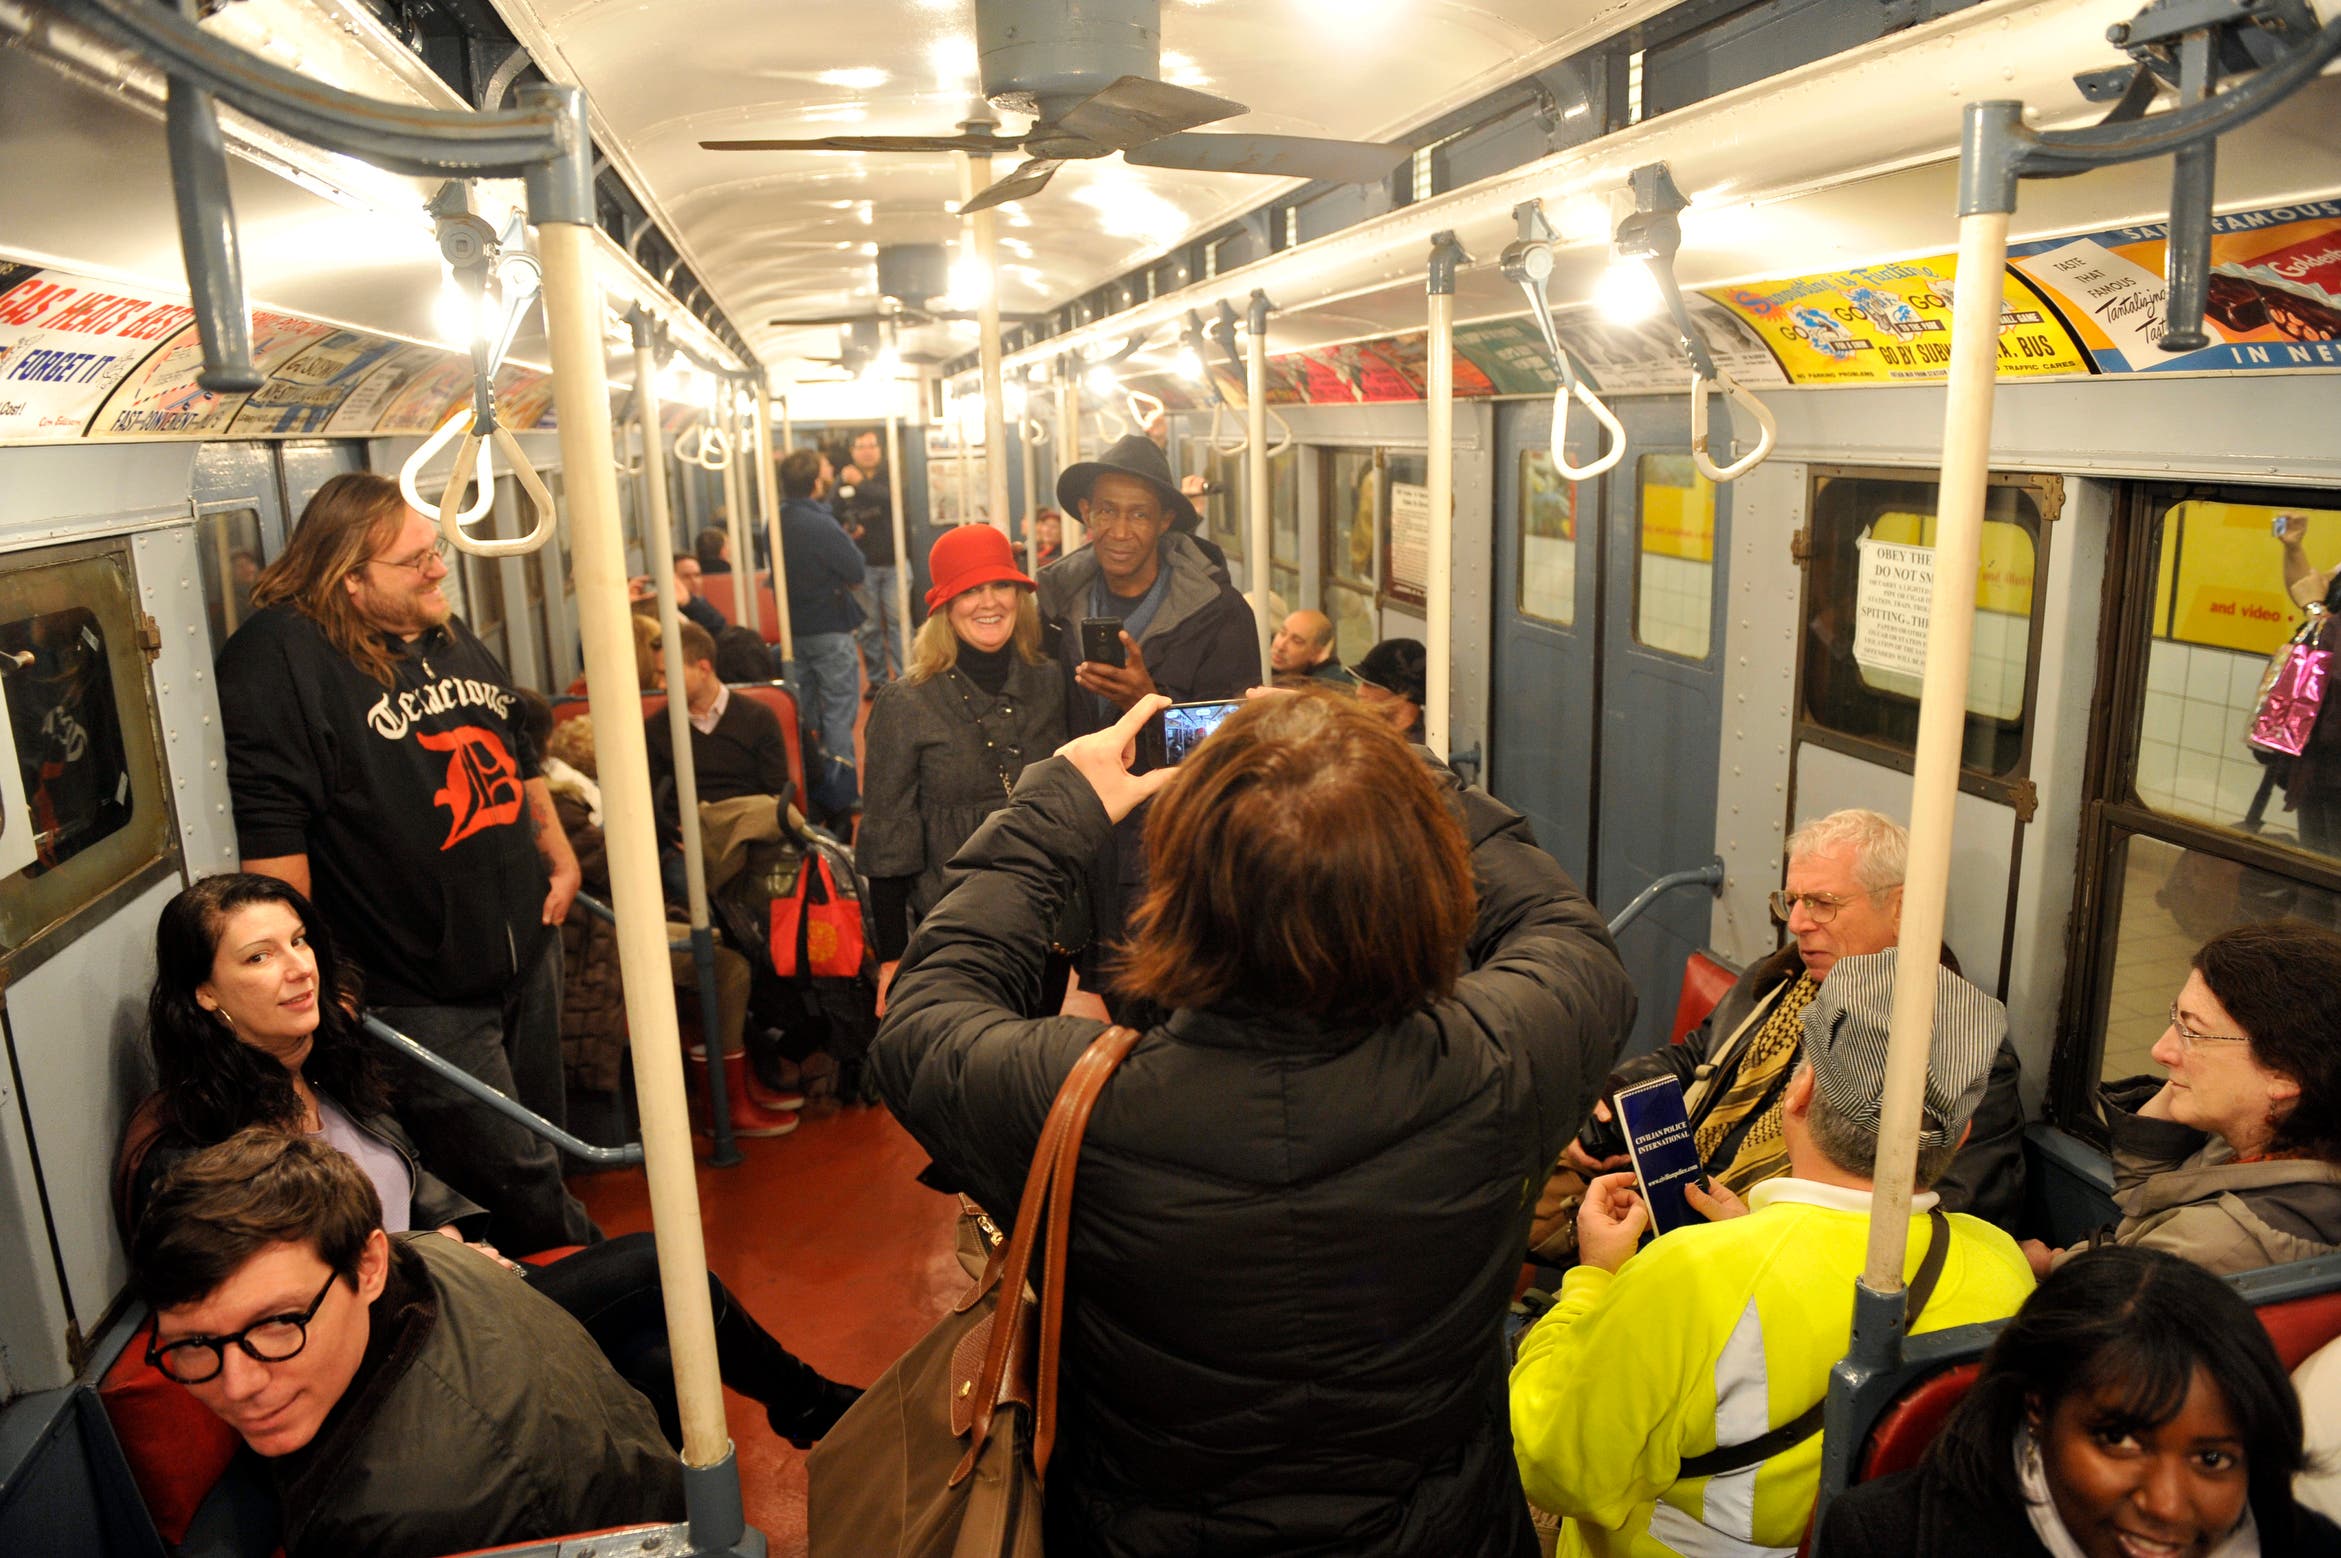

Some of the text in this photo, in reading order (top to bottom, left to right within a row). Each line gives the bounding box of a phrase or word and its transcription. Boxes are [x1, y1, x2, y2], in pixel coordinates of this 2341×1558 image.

[2053, 257, 2087, 272] TASTE
[2267, 248, 2341, 278] Goldenb
[2074, 269, 2107, 284] THAT
[2087, 277, 2137, 298] FAMOUS
[0, 279, 197, 341] GAS HEATS BEST
[1908, 294, 1946, 310] GO
[1834, 306, 1868, 321] GO
[1780, 325, 1809, 341] GO
[2135, 317, 2167, 344] Tast
[1879, 346, 1899, 365] GO
[1897, 345, 1916, 365] BY
[2016, 334, 2056, 358] BUS
[2230, 343, 2341, 364] IN NE
[7, 349, 117, 384] FORGET IT
[2043, 360, 2076, 369] CARES
[1877, 547, 1933, 565] OBEY THE
[1875, 564, 1891, 577] DO
[1894, 567, 1918, 582] NOT
[1878, 580, 1897, 589] CARRY
[1861, 606, 1905, 625] SPITTING
[2210, 601, 2281, 623] and video
[415, 725, 524, 851] D
[1635, 1121, 1688, 1146] CIVILIAN POLICE
[1638, 1130, 1690, 1155] INTERNATIONAL
